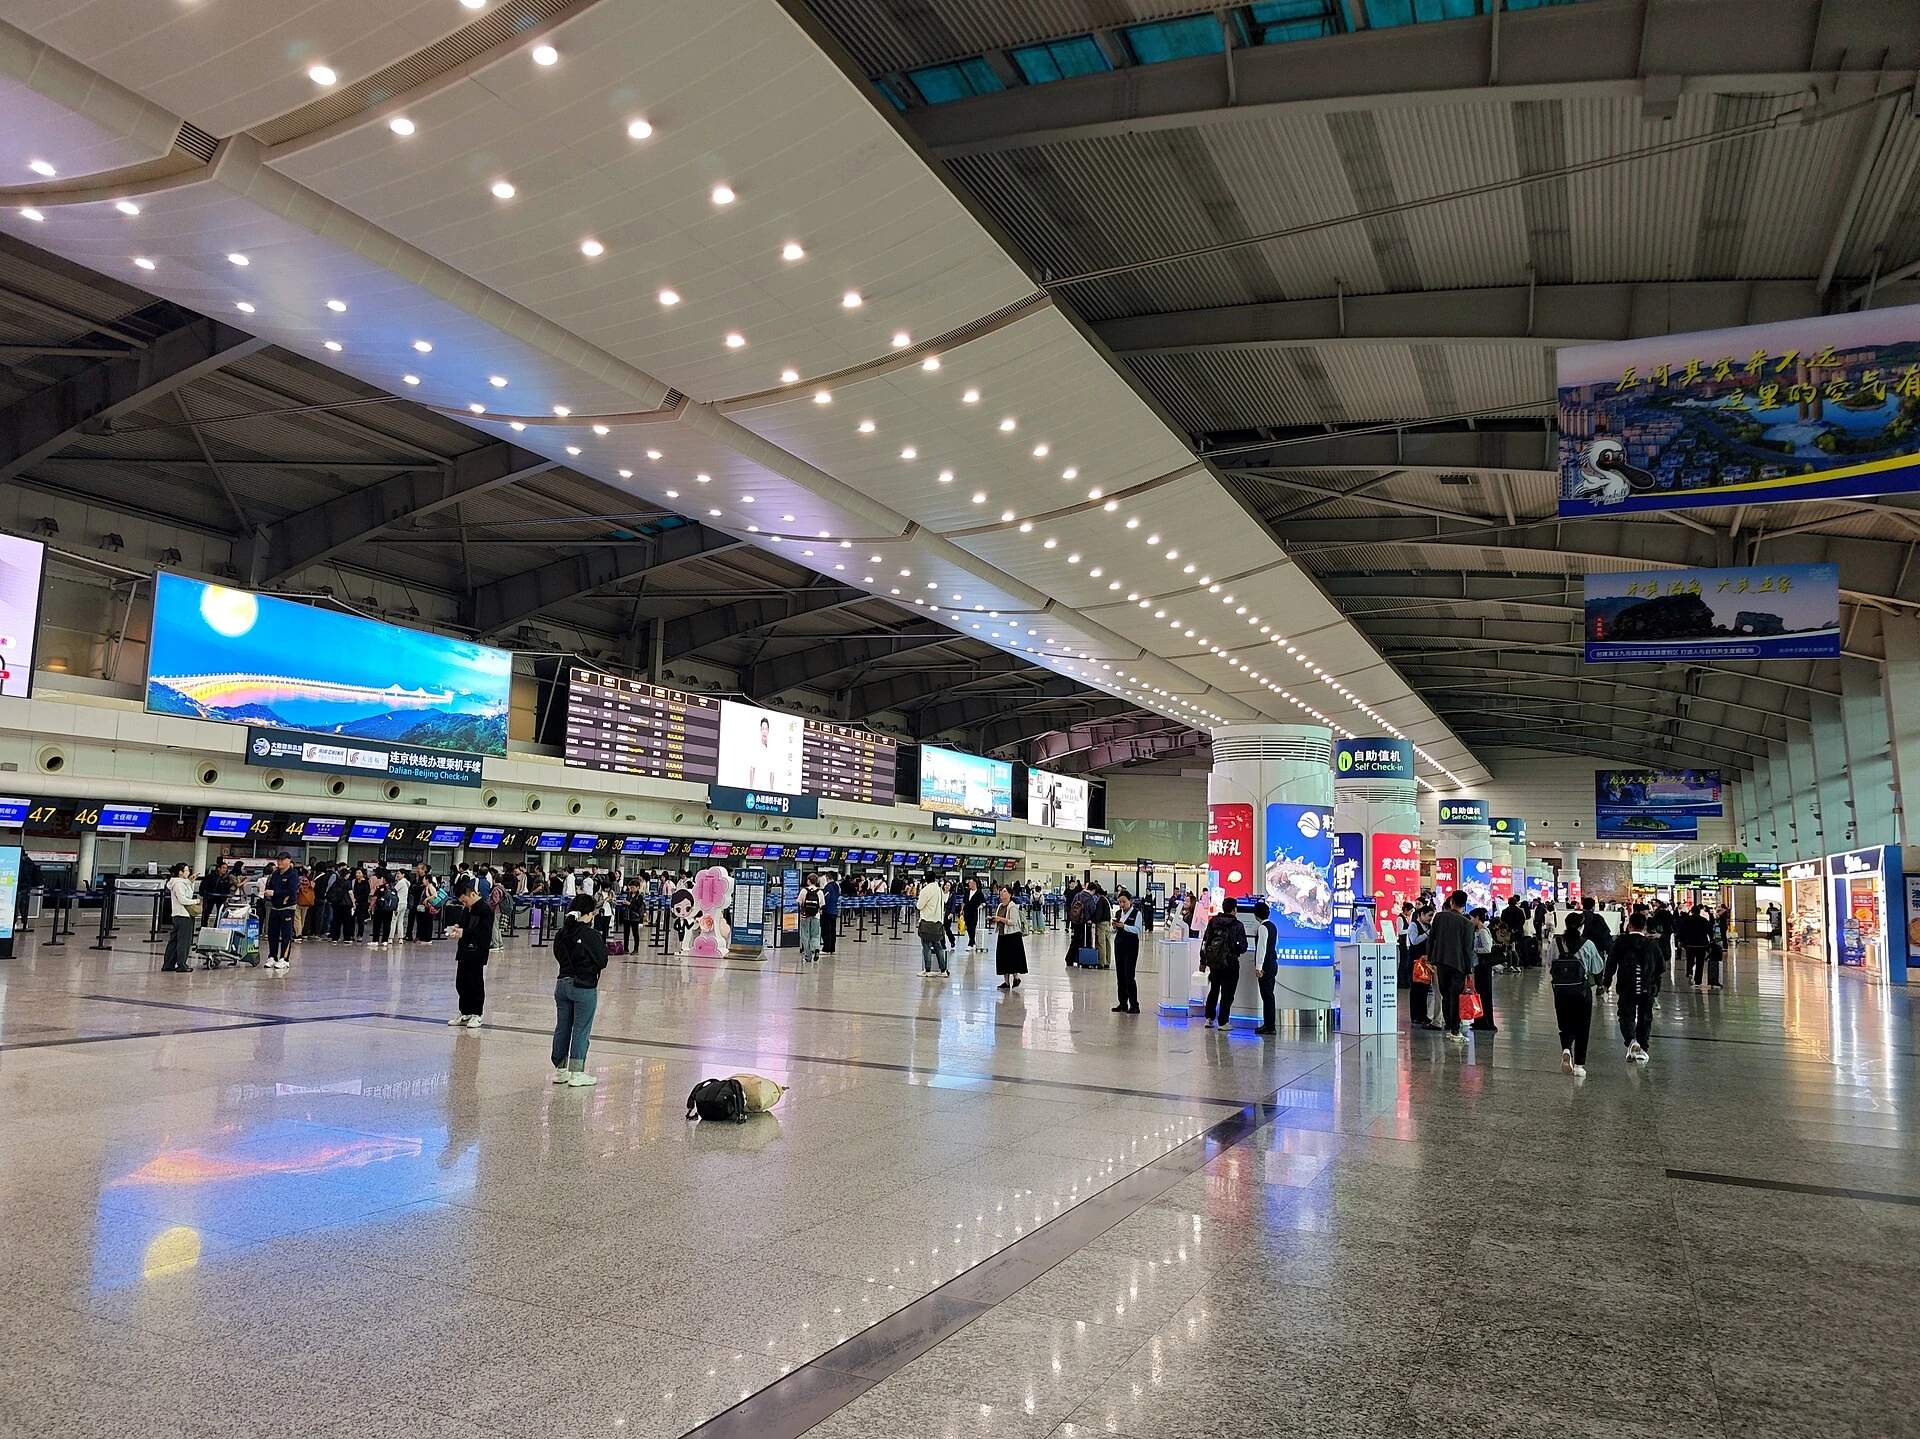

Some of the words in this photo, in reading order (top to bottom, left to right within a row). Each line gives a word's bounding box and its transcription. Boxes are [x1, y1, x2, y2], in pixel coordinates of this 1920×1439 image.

[389, 751, 481, 773] 连京快线办理乘机手续
[1354, 750, 1401, 762] 自助值机
[388, 765, 439, 780] Dalian-Beijing
[439, 771, 469, 781] Check-in
[1355, 763, 1370, 771] Self
[1371, 763, 1404, 772] Check-in
[782, 797, 789, 812] B
[28, 806, 57, 823] 47
[74, 809, 98, 824] 46
[250, 819, 271, 834] 45
[285, 821, 305, 836] 44
[387, 827, 404, 841] 43
[416, 829, 432, 842] 42
[502, 833, 516, 846] 41
[525, 835, 539, 847] 40
[595, 839, 608, 850] 39
[611, 839, 624, 851] 38
[667, 843, 679, 853] 37
[681, 843, 691, 854] 36
[730, 846, 739, 856] 35
[739, 846, 748, 856] 34
[781, 848, 789, 858] 33
[829, 851, 836, 859] 31
[1365, 966, 1373, 1018] 悦旅出行
